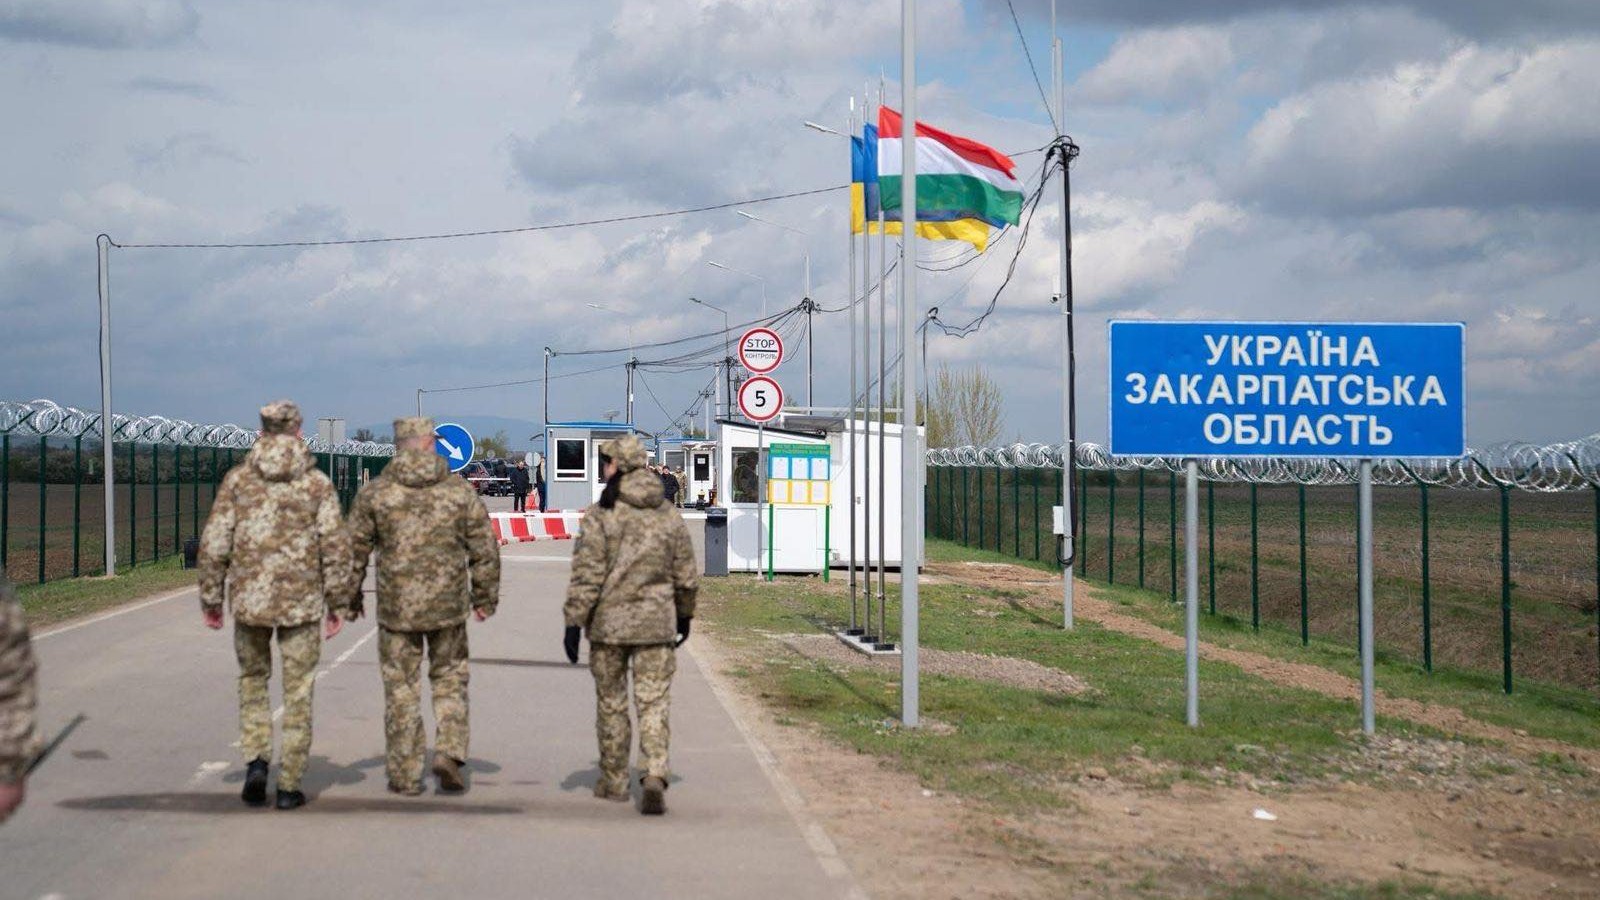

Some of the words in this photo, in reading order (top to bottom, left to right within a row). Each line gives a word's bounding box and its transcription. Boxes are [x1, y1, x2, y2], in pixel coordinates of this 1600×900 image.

[747, 339, 775, 348] STOP
[1204, 330, 1380, 366] УКРАЇНА
[745, 352, 777, 360] КОНТРОЛЬ
[755, 391, 766, 407] 5
[1125, 373, 1447, 406] ЗАКАРПАТСЬКА
[1203, 413, 1393, 446] ОБЛАСТЬ
